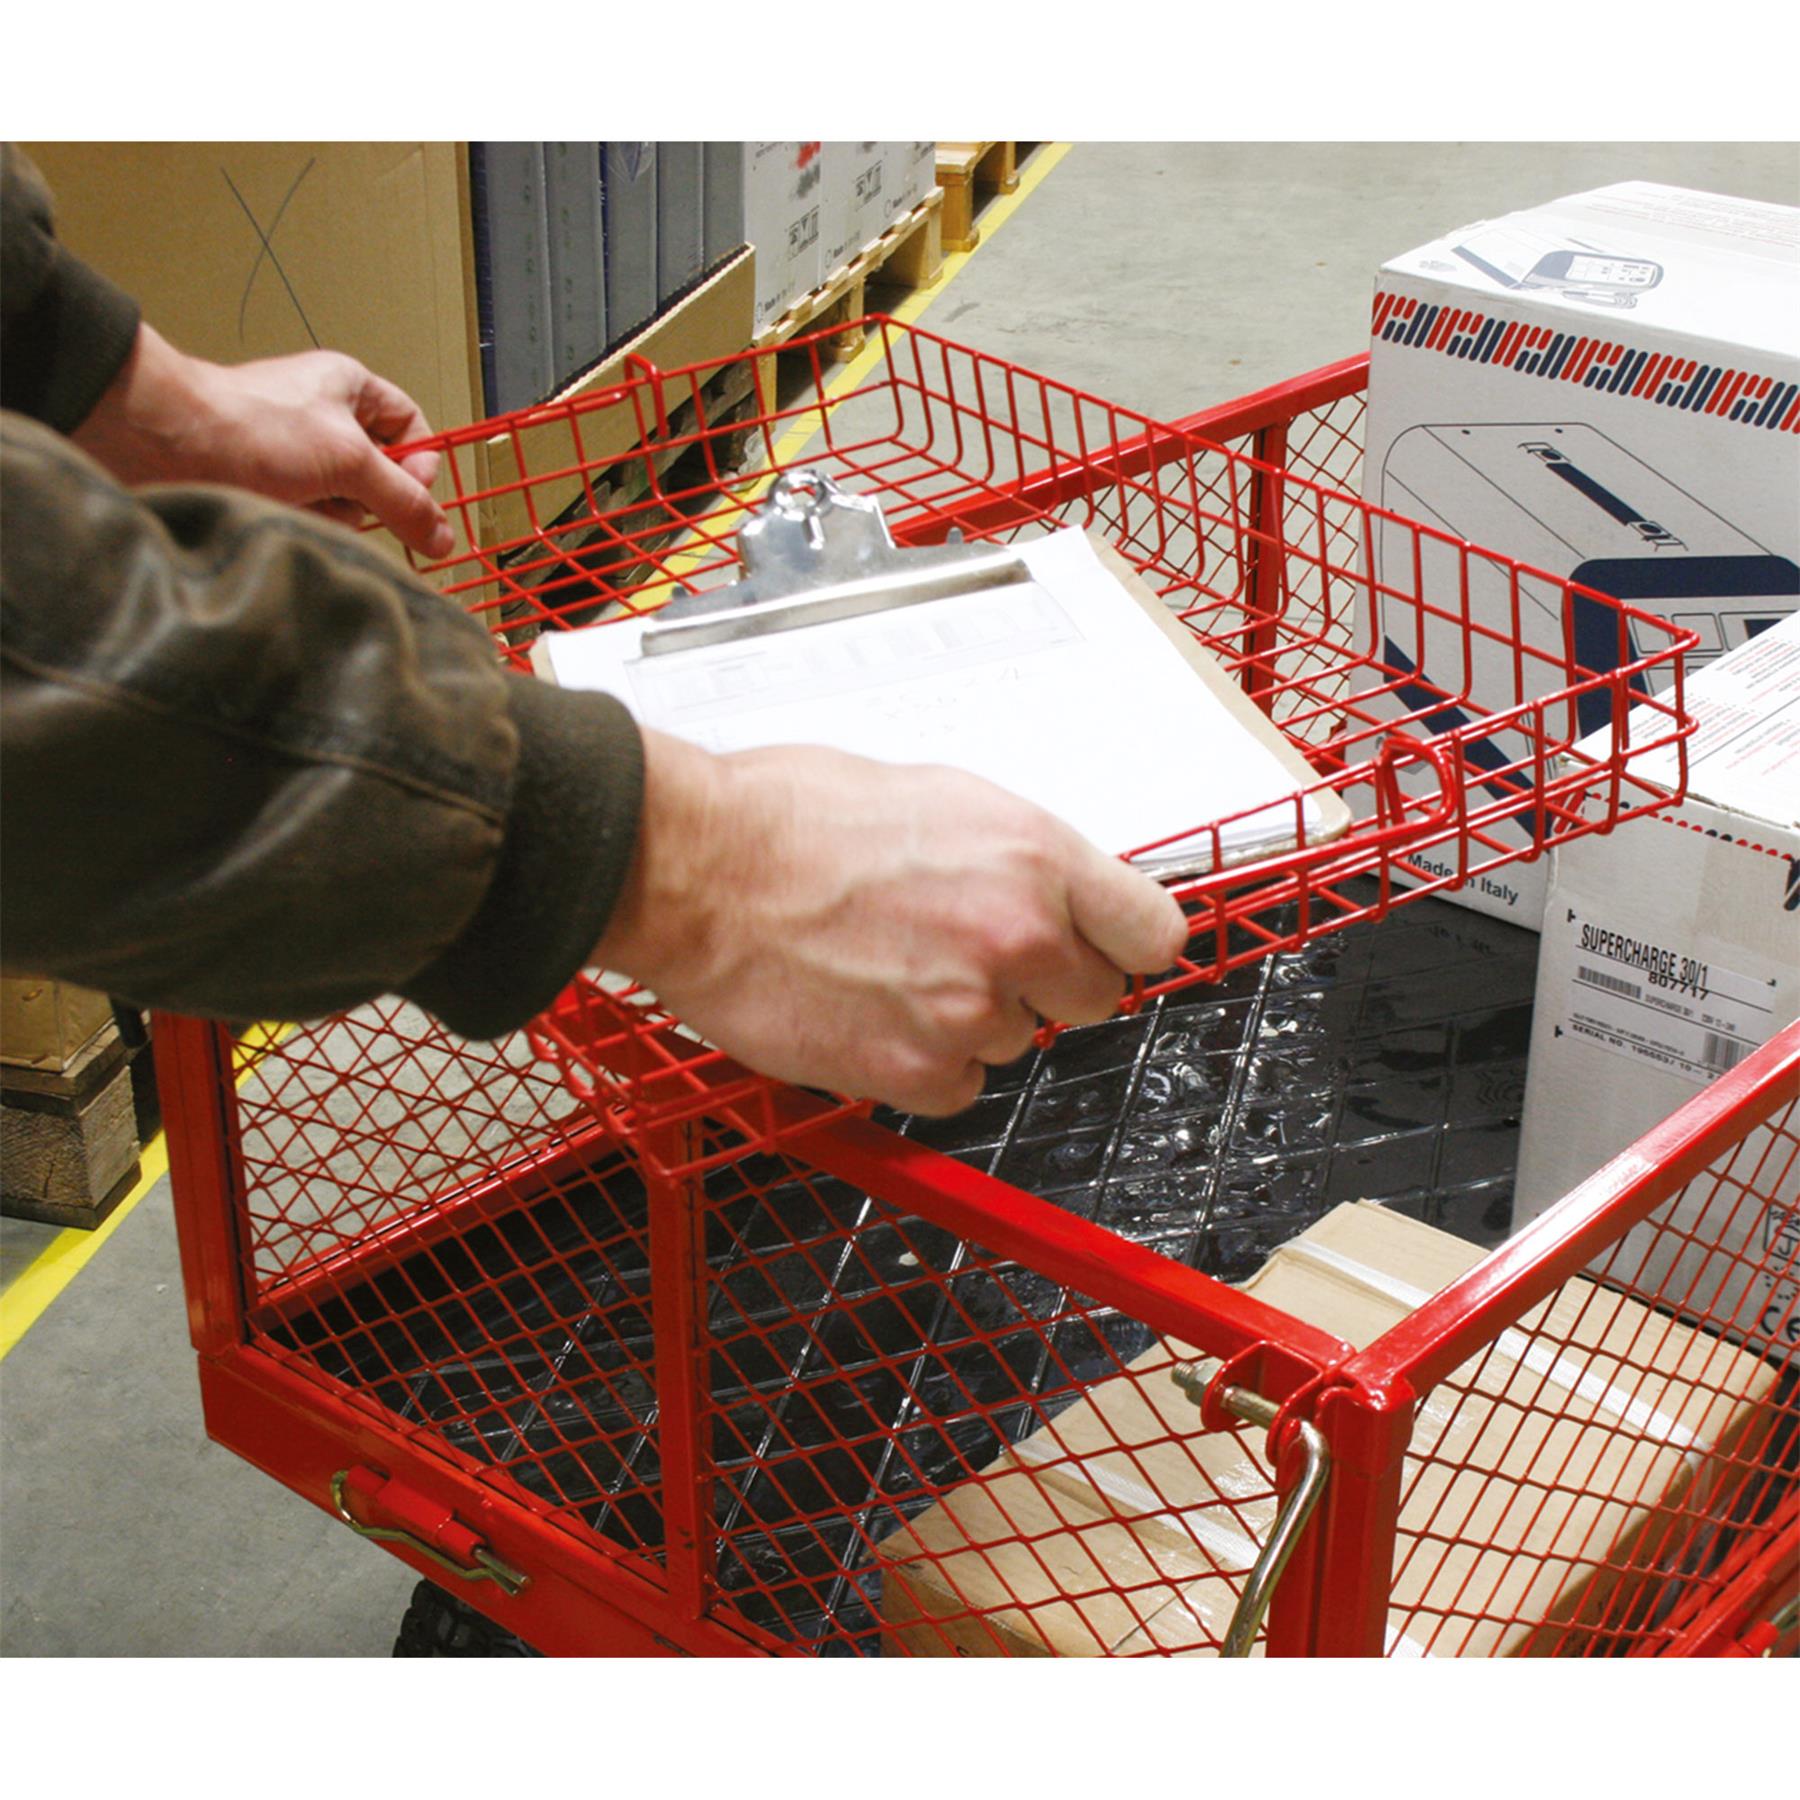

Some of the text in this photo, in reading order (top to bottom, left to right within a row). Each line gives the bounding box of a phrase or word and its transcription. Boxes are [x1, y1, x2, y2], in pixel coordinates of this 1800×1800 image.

[1407, 854, 1454, 877] Made
[1480, 877, 1519, 906] Italy
[1580, 923, 1708, 988] SUPERCHARGE 30/1
[1648, 970, 1710, 1001] 807717
